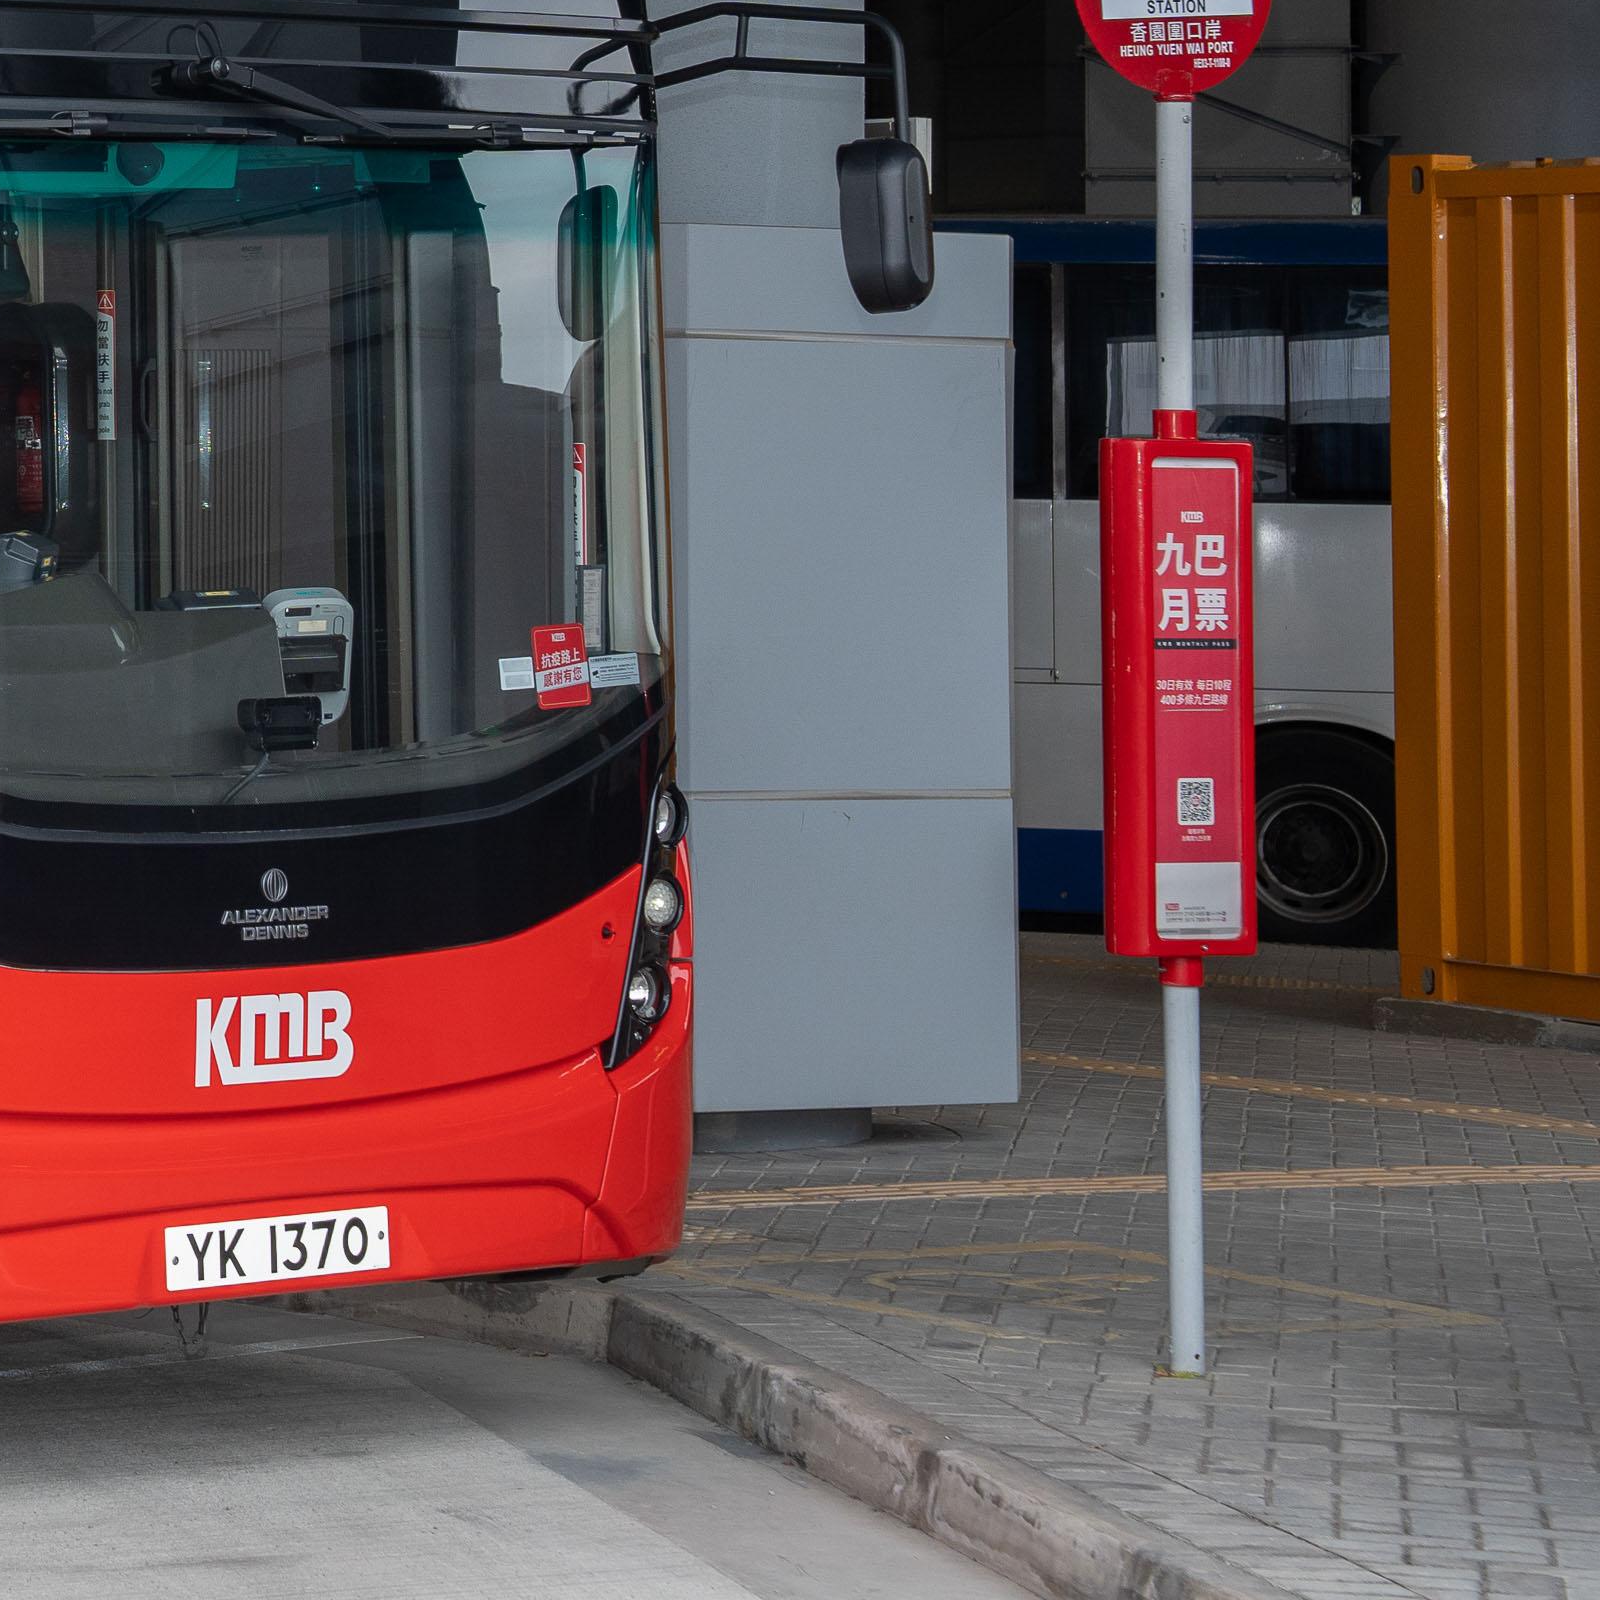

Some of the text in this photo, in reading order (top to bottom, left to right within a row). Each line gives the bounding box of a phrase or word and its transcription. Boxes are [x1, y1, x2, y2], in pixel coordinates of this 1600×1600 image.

[1147, 0, 1207, 15] STATION
[1129, 19, 1222, 43] 香園圍口岸
[1120, 41, 1234, 57] HEUNG YUEN WAI PORT
[1181, 510, 1204, 524] KMB
[1155, 532, 1228, 577] 九巴
[1157, 587, 1230, 633] 月票
[541, 647, 581, 669] 抗疫路上
[220, 905, 330, 925] ALEXANDER
[242, 922, 310, 941] DENNIS
[194, 990, 355, 1088] KMB
[186, 1215, 369, 1282] YK 1370
